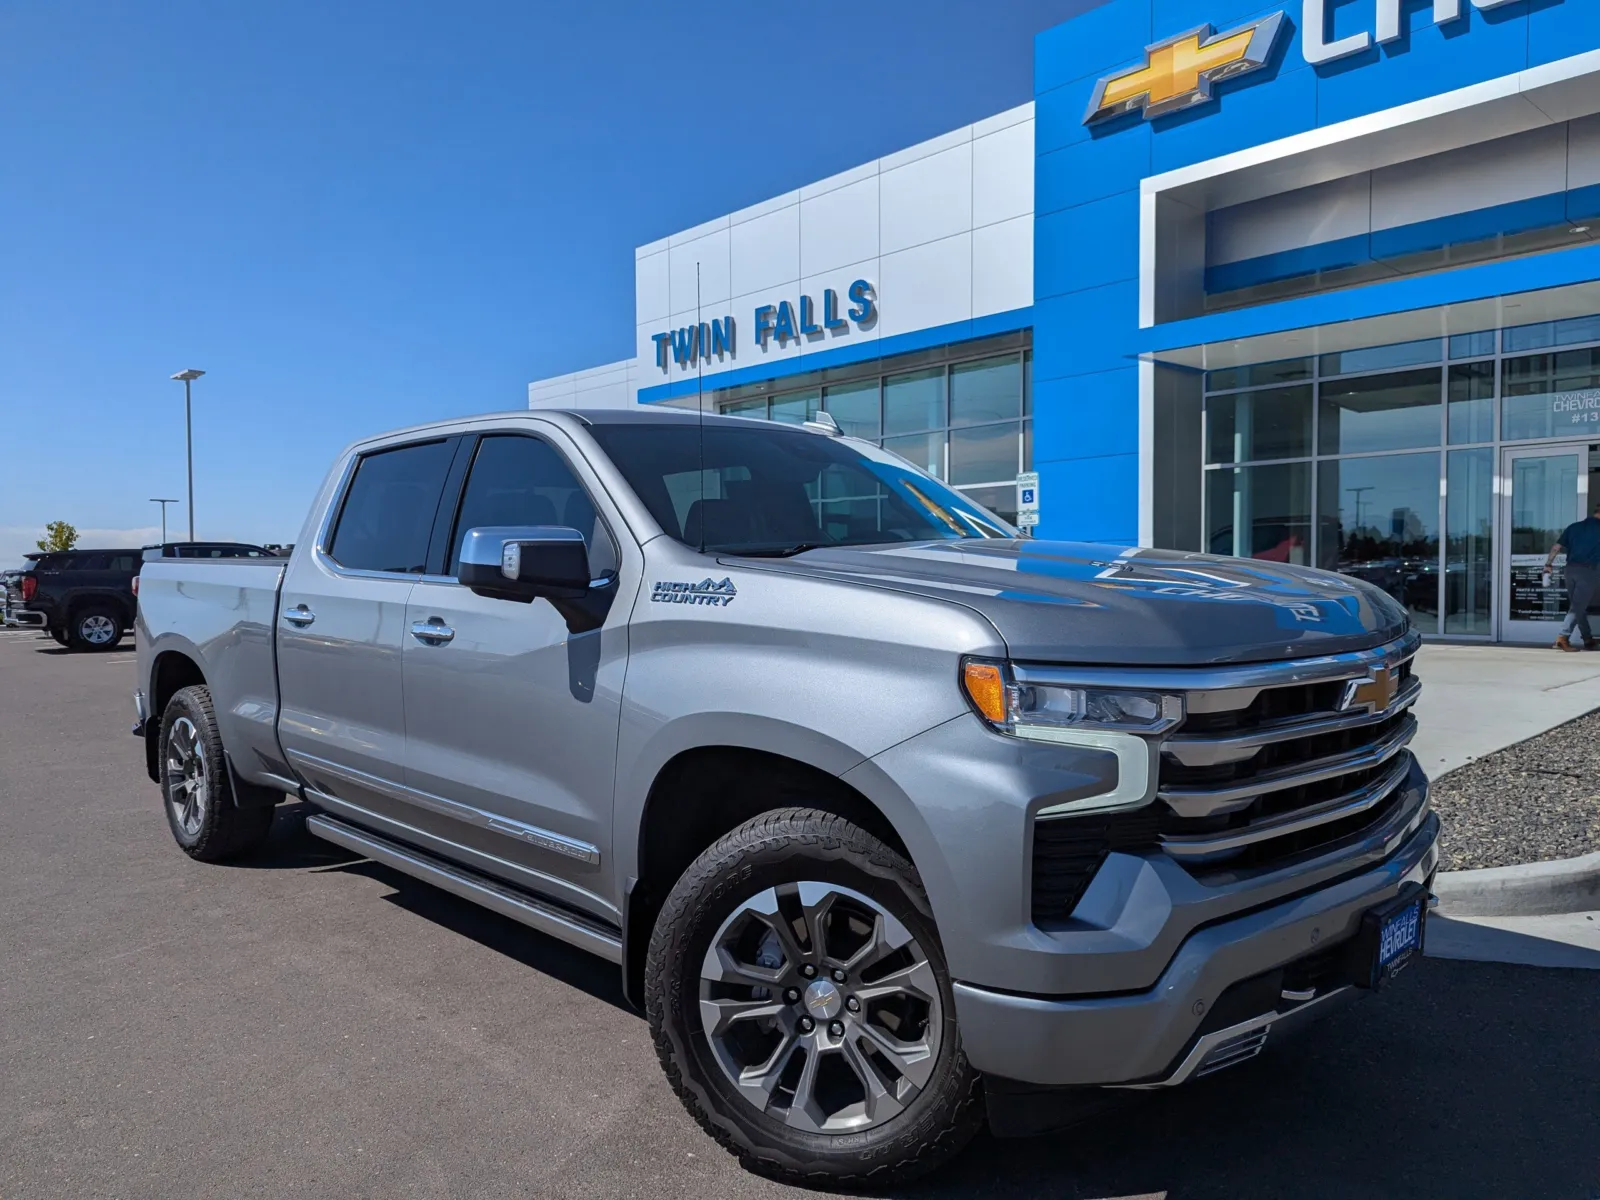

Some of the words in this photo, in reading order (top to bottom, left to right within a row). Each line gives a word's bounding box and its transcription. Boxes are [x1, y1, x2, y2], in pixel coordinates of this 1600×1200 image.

[652, 316, 733, 368] TWIN
[755, 279, 874, 345] FALLS
[650, 592, 735, 606] COUNTRY
[654, 581, 697, 593] HIGH
[1379, 919, 1417, 962] HEVROLET
[1381, 906, 1420, 941] WINFALLS
